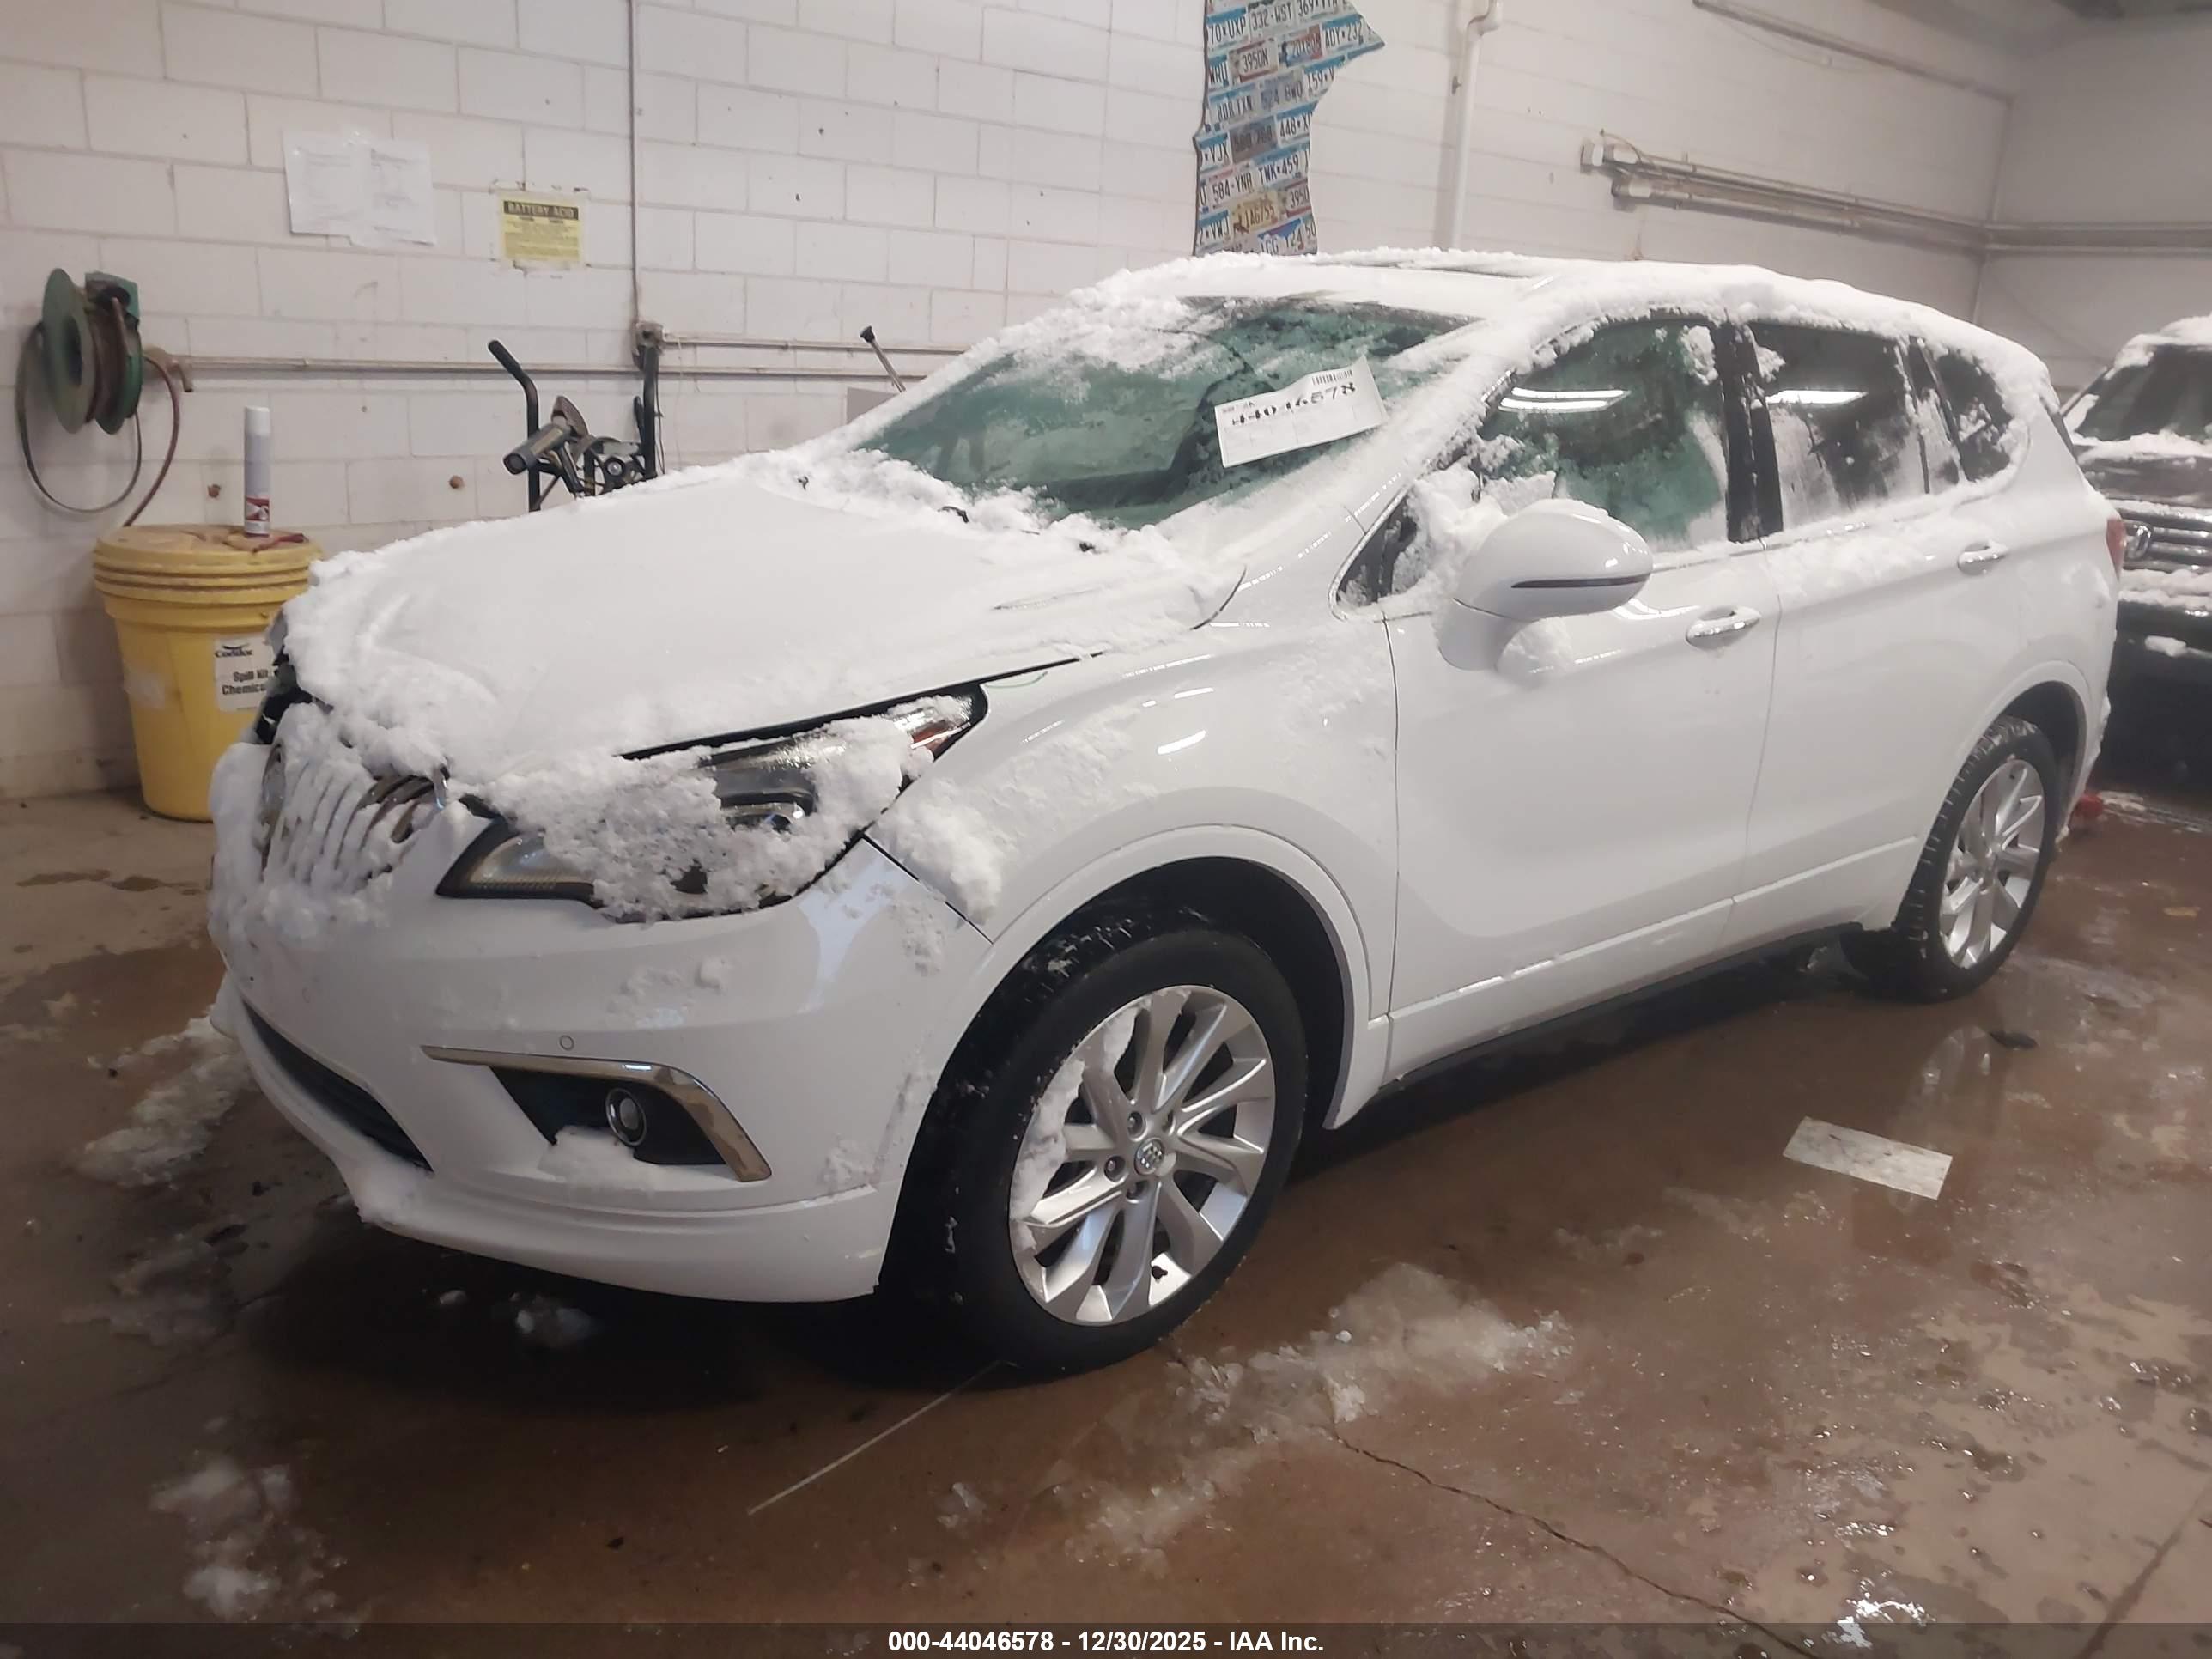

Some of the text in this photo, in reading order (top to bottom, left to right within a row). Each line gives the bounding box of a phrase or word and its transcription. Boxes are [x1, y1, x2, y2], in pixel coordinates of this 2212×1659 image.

[507, 202, 574, 219] BATTERY ACID
[233, 669, 269, 683] Spill Kit
[222, 684, 266, 696] Chemica
